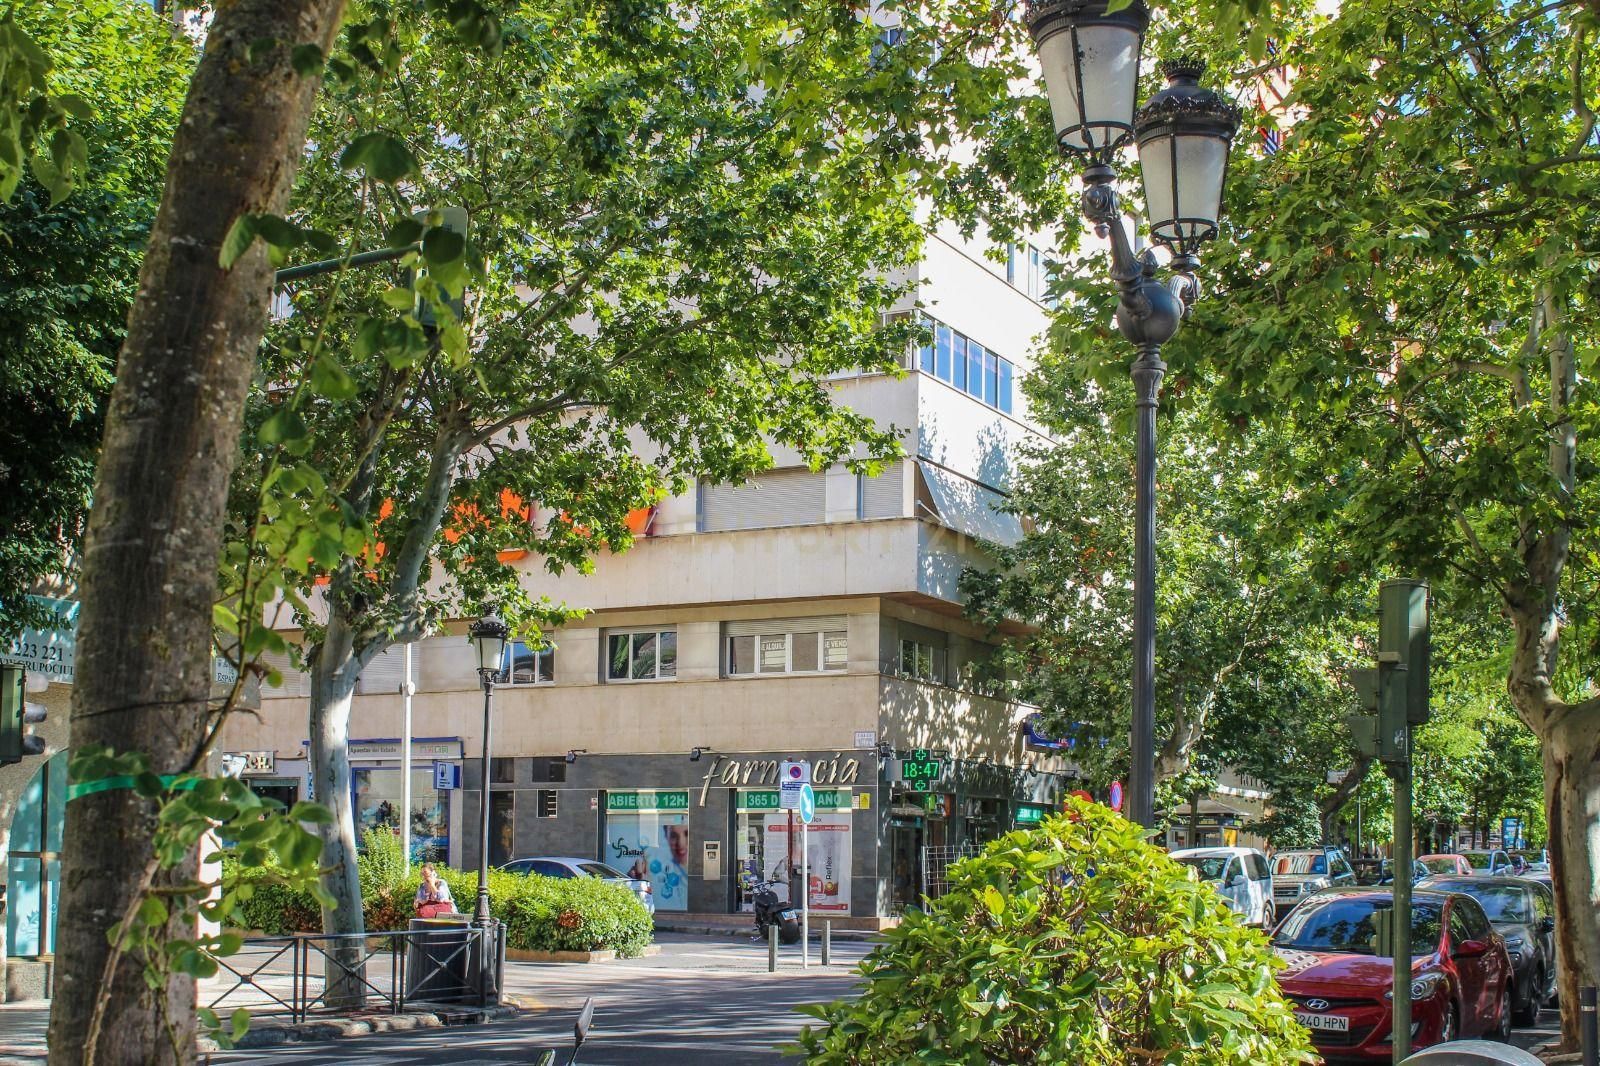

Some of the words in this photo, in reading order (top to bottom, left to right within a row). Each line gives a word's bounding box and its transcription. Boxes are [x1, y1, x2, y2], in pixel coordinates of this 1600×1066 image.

[42, 645, 63, 661] 221
[903, 762, 939, 778] 18:47
[699, 752, 860, 808] farmcía
[609, 795, 659, 807] ABIERTO
[748, 794, 768, 806] 365
[817, 791, 842, 806] AÑO
[1323, 1016, 1346, 1030] HPN
